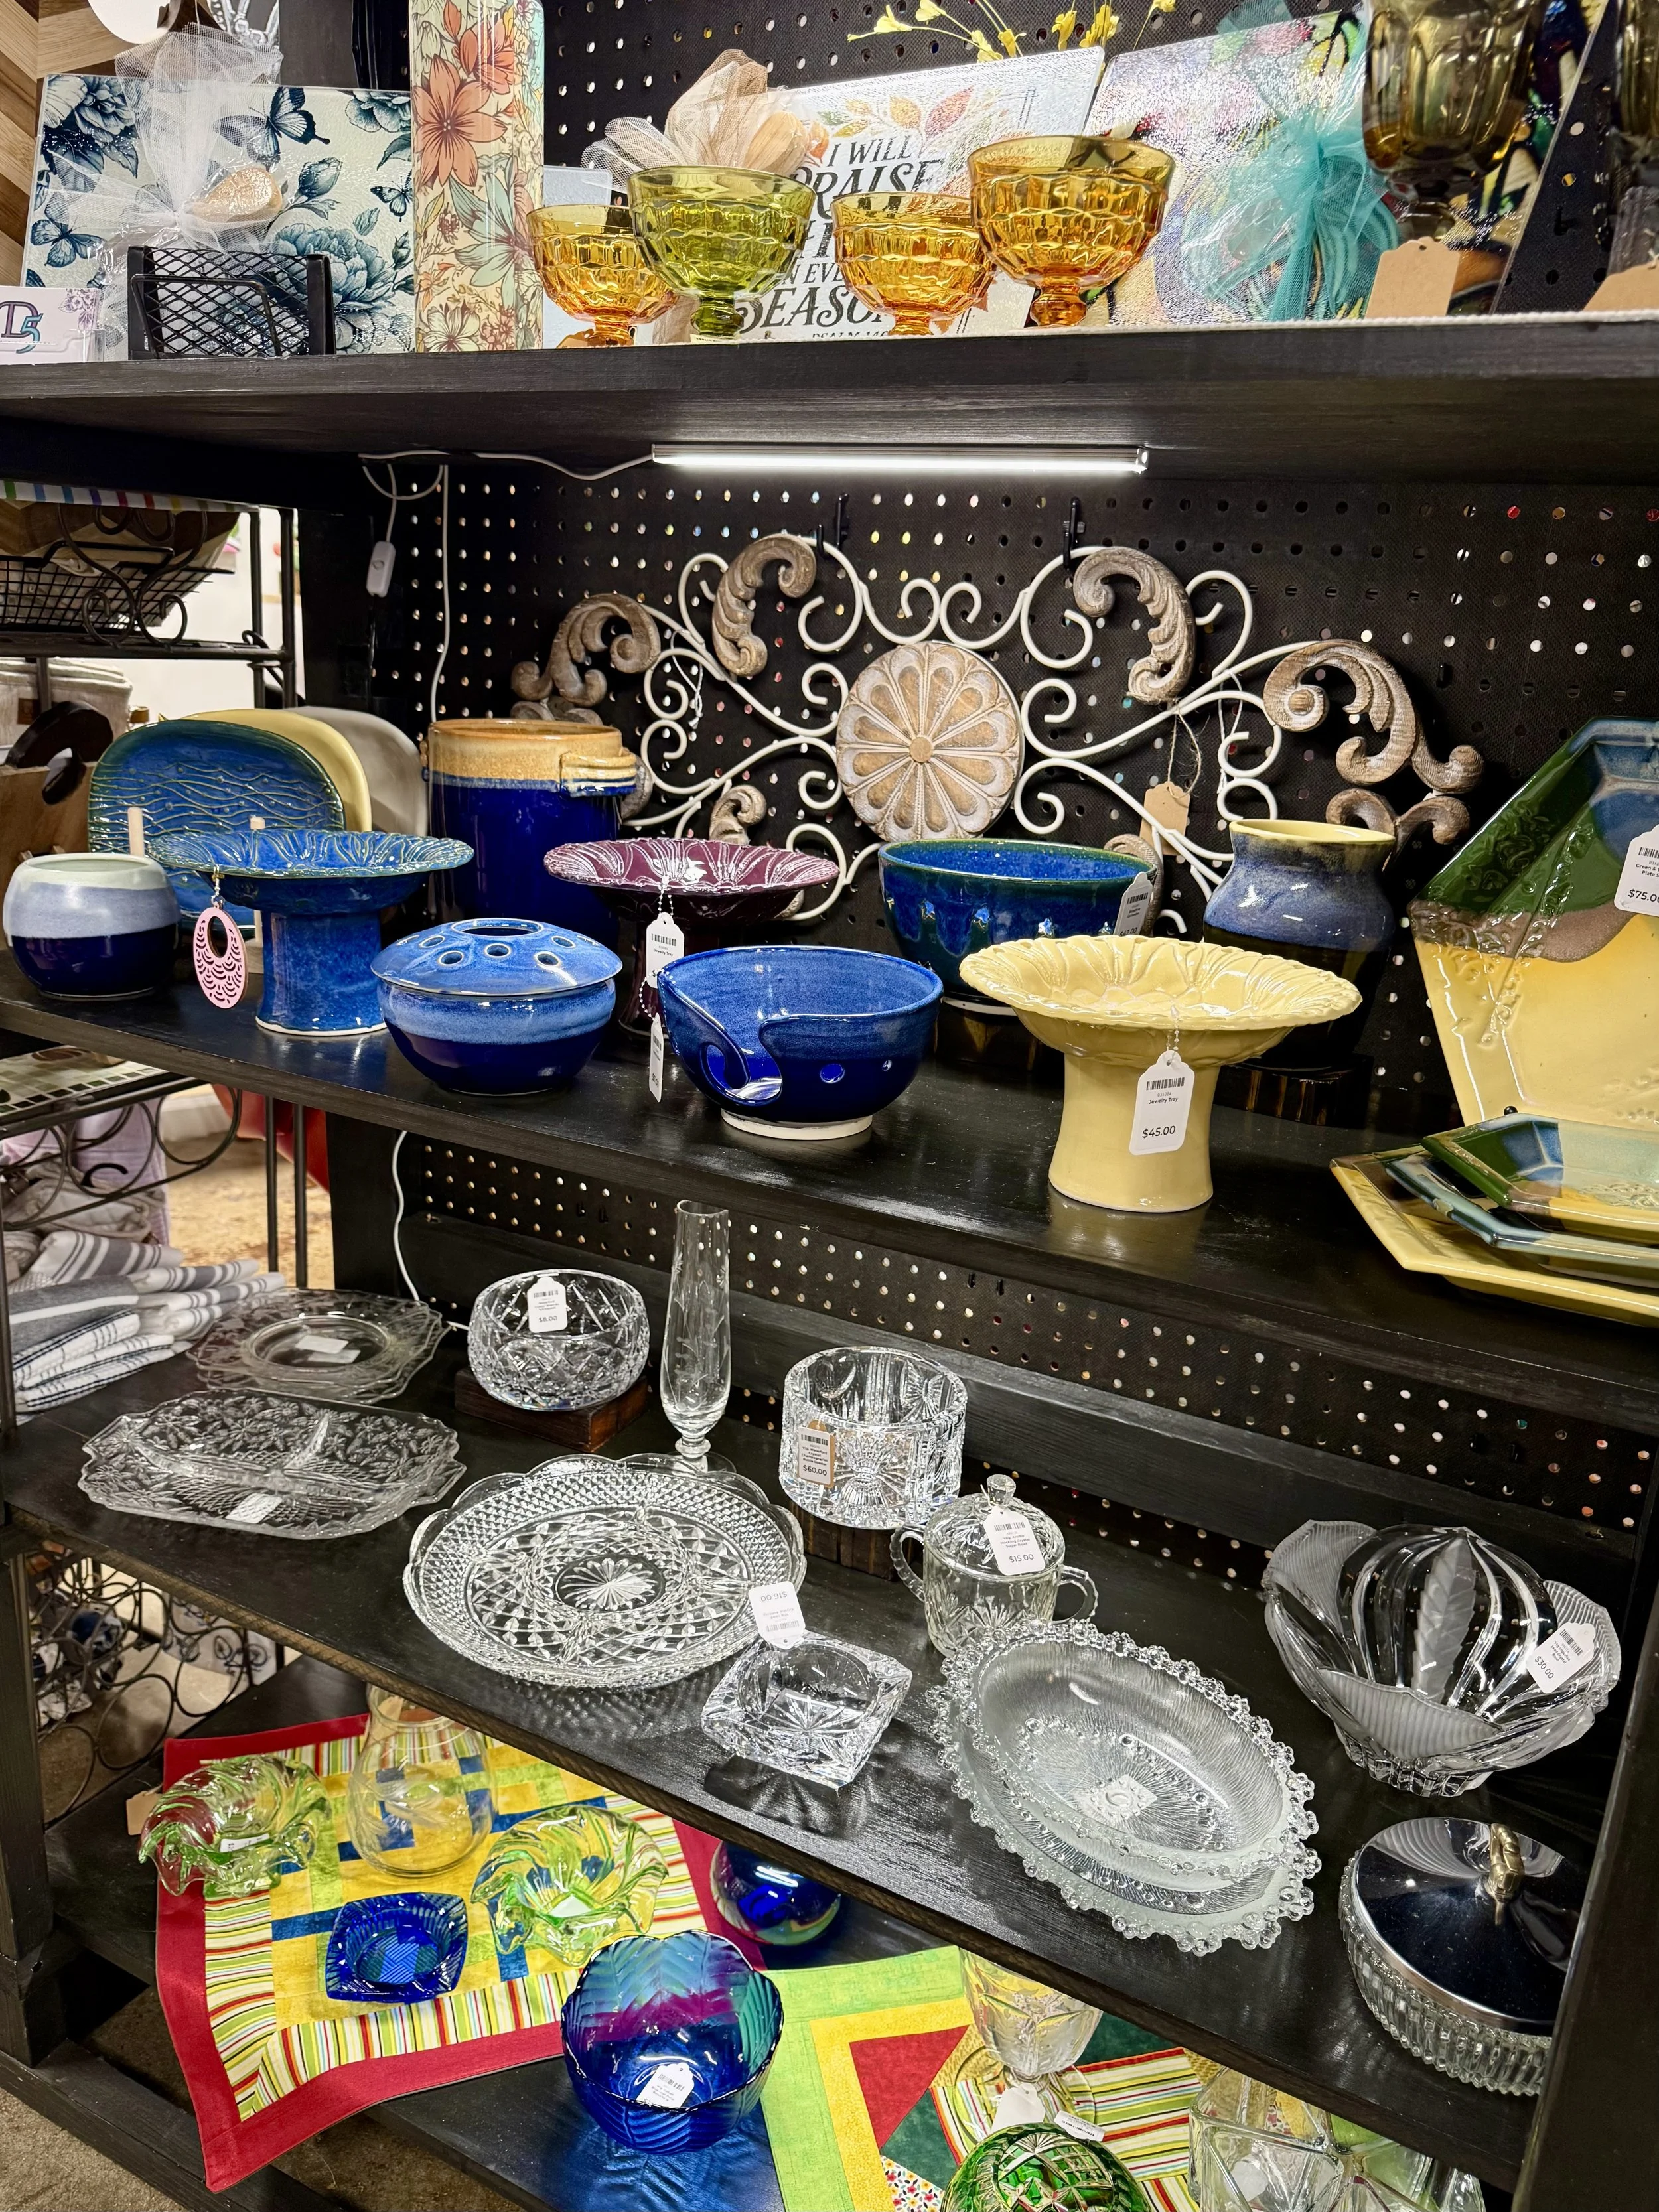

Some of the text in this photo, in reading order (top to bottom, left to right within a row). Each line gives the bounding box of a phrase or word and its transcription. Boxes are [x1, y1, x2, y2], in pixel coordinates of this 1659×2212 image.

[828, 135, 914, 166] I WILL
[735, 285, 882, 334] SEASO
[1628, 889, 1659, 904] $75.0
[1142, 1125, 1176, 1139] $45.00
[803, 1465, 828, 1476] $60.00
[1009, 1554, 1034, 1563] $15.00
[760, 1591, 788, 1602] $16.00
[1535, 1655, 1554, 1679] $30.00
